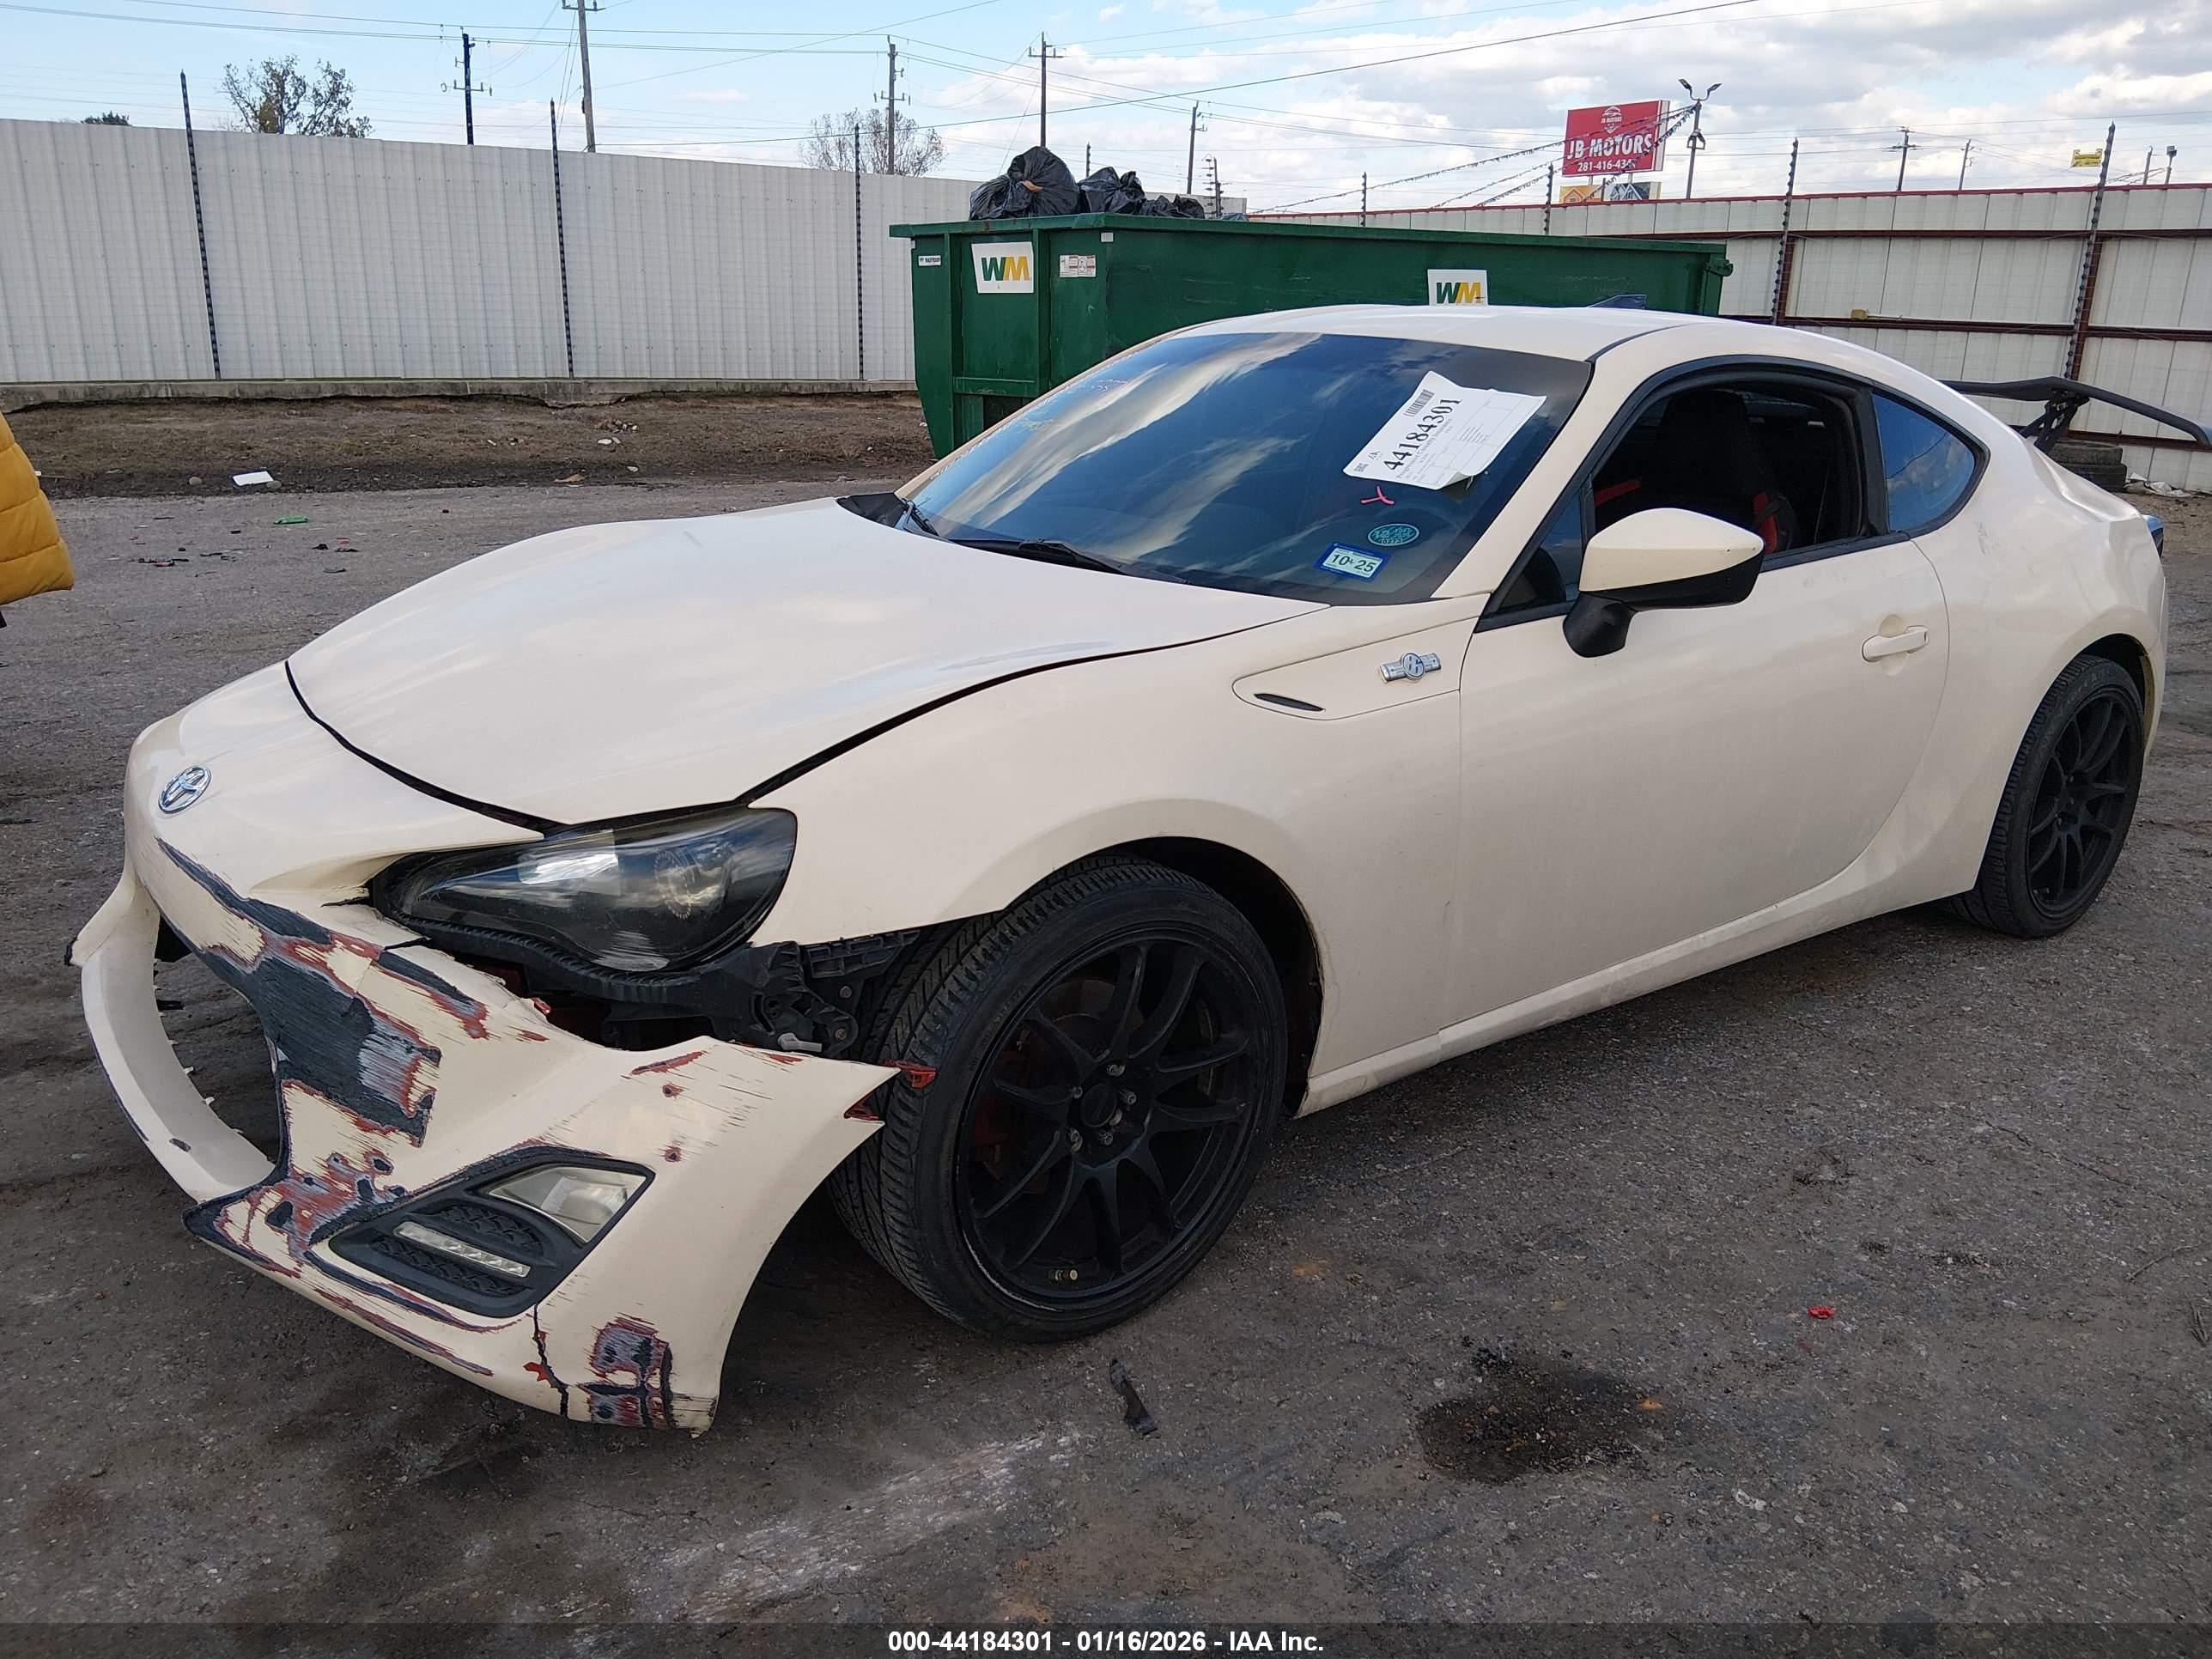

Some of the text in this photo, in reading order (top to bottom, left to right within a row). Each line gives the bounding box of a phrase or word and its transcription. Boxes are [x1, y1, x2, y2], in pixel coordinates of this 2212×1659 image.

[1567, 134, 1654, 159] JB MOTORS
[981, 257, 1030, 281] WM
[1436, 283, 1480, 303] WM
[1383, 399, 1463, 471] 44184301
[1332, 554, 1376, 573] 10 25
